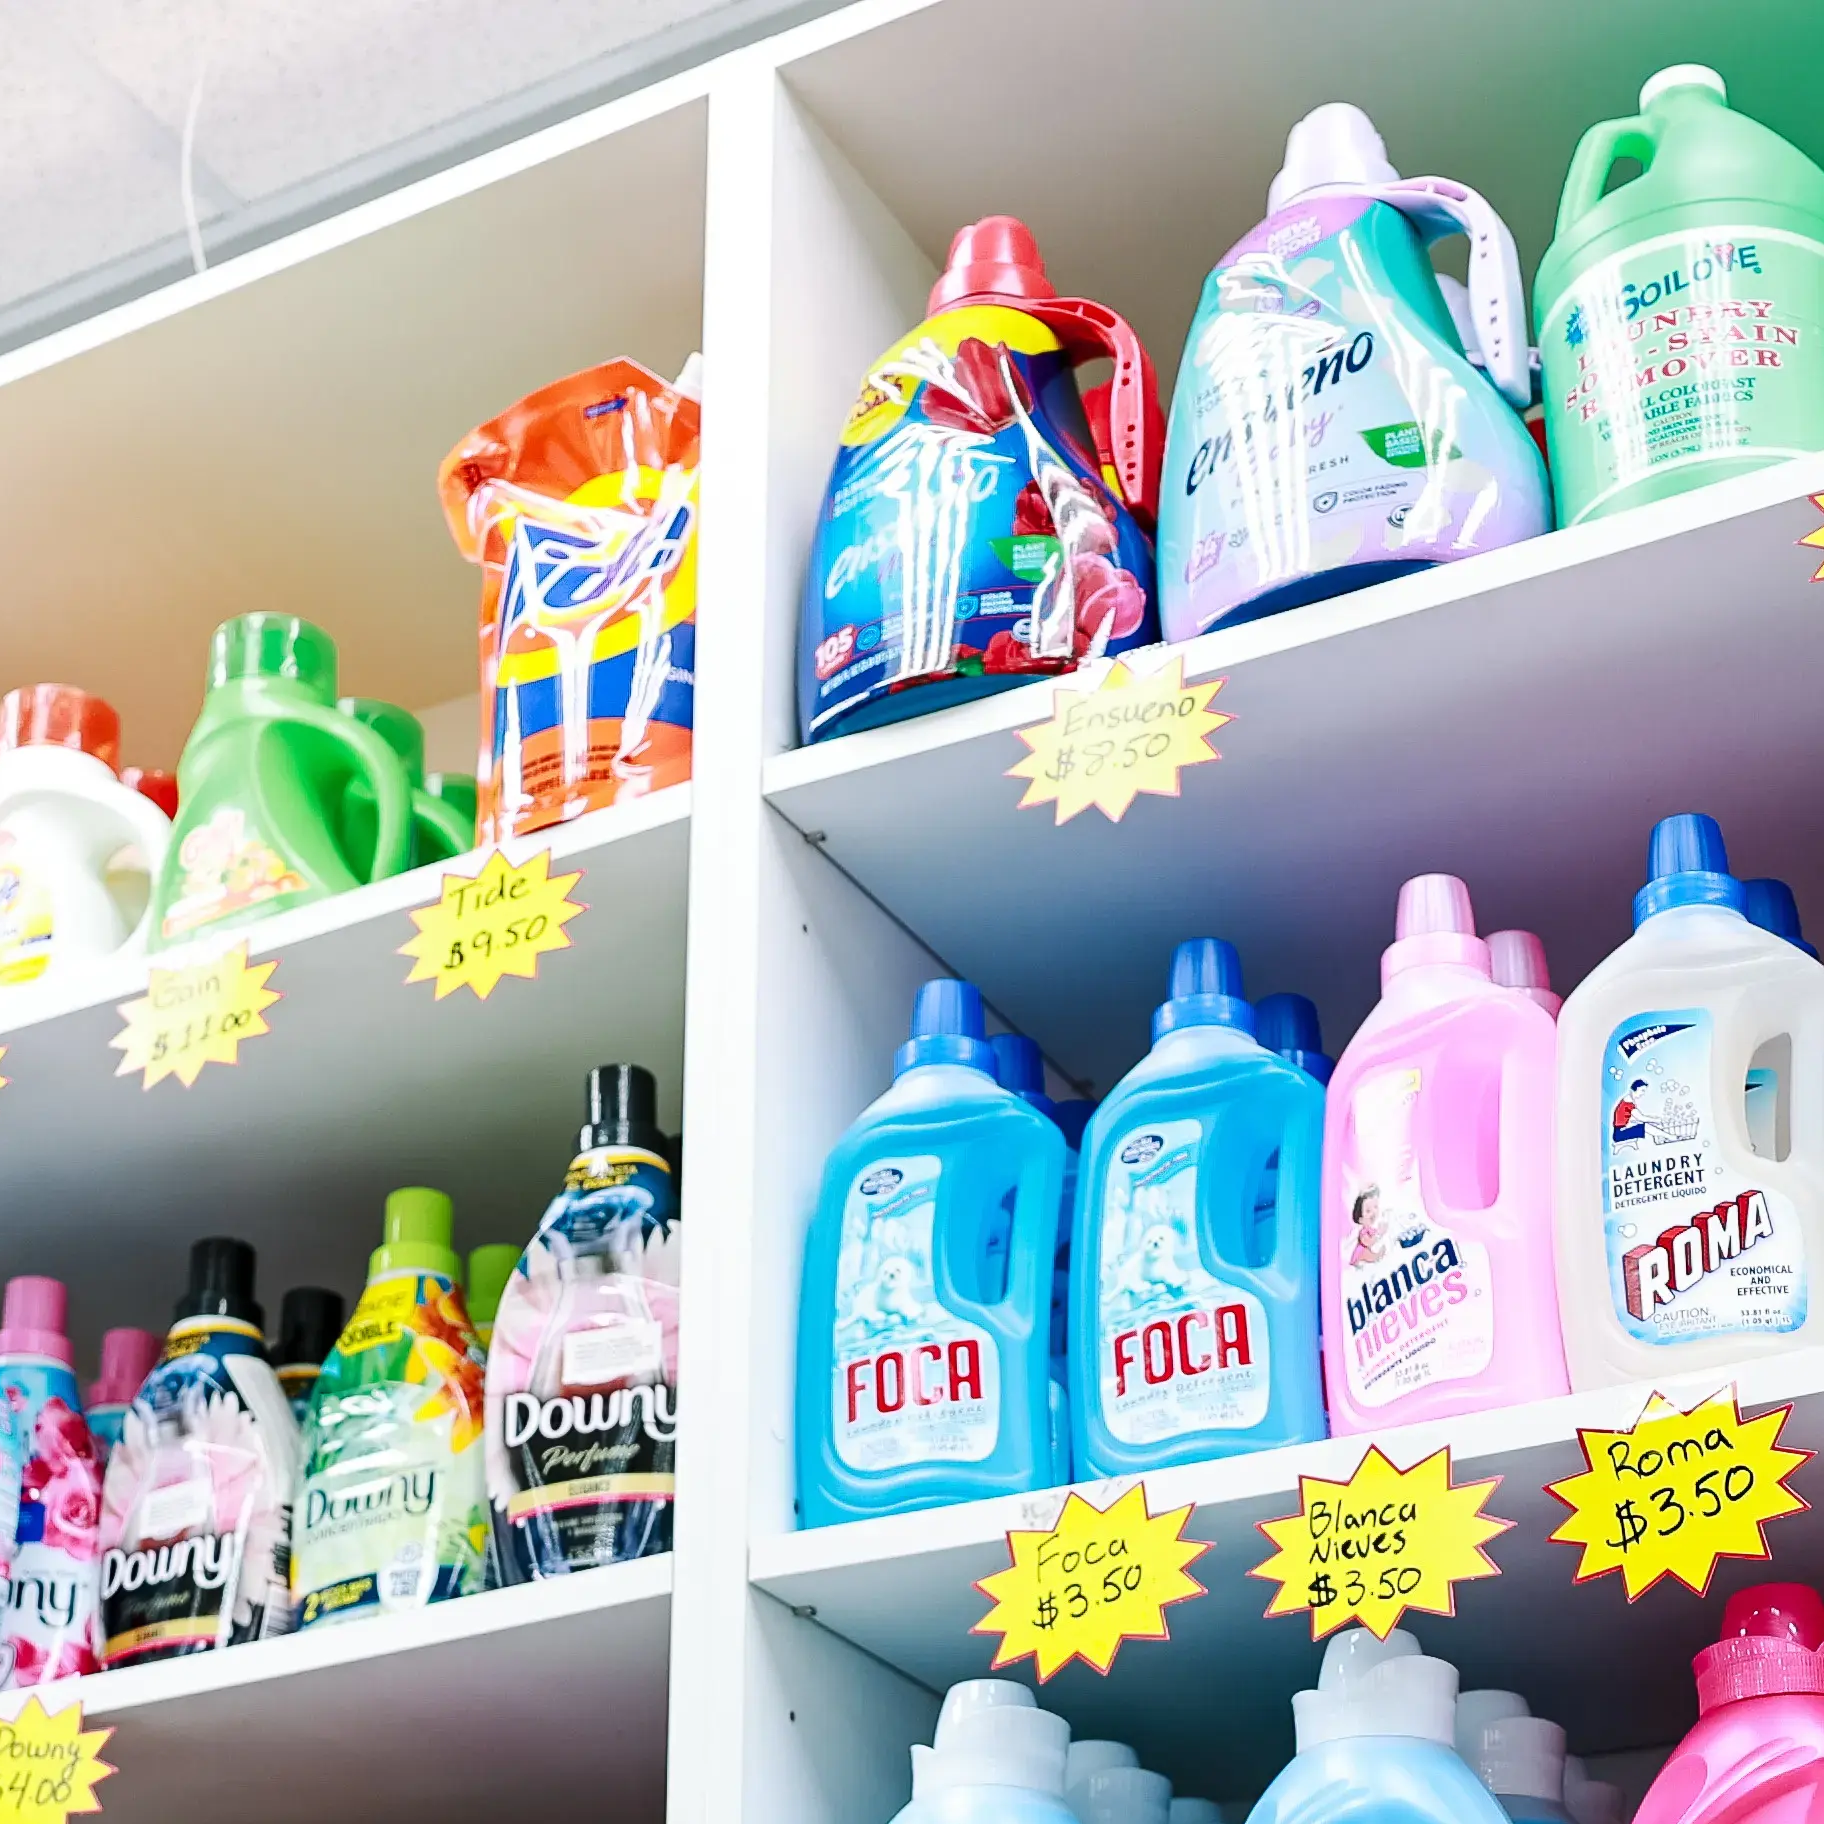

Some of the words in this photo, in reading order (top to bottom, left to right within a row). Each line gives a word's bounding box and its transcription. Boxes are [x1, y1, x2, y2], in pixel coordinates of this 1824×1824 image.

[1045, 732, 1171, 781] $8.50
[448, 876, 530, 915] Tide
[442, 915, 549, 970] $9.50
[1611, 1153, 1704, 1184] LAUNDRY
[1613, 1169, 1706, 1198] DETERGENT
[1623, 1190, 1774, 1321] ROMA
[1729, 1264, 1793, 1277] ECONOMICAL
[1736, 1284, 1789, 1297] EFFECTIVE
[1749, 1275, 1772, 1285] AND
[1112, 1304, 1253, 1398] FOCA
[845, 1339, 985, 1424] FOCA
[1609, 1429, 1733, 1483] Roma
[304, 1466, 440, 1528] Downy
[1309, 1500, 1418, 1536] Blanca
[1607, 1464, 1754, 1555] $3.50
[99, 1526, 241, 1601] Downy
[1036, 1536, 1128, 1582] Foca
[1309, 1530, 1406, 1564] Nieves
[1031, 1564, 1142, 1630] $3.50
[1308, 1567, 1422, 1608] $3.50
